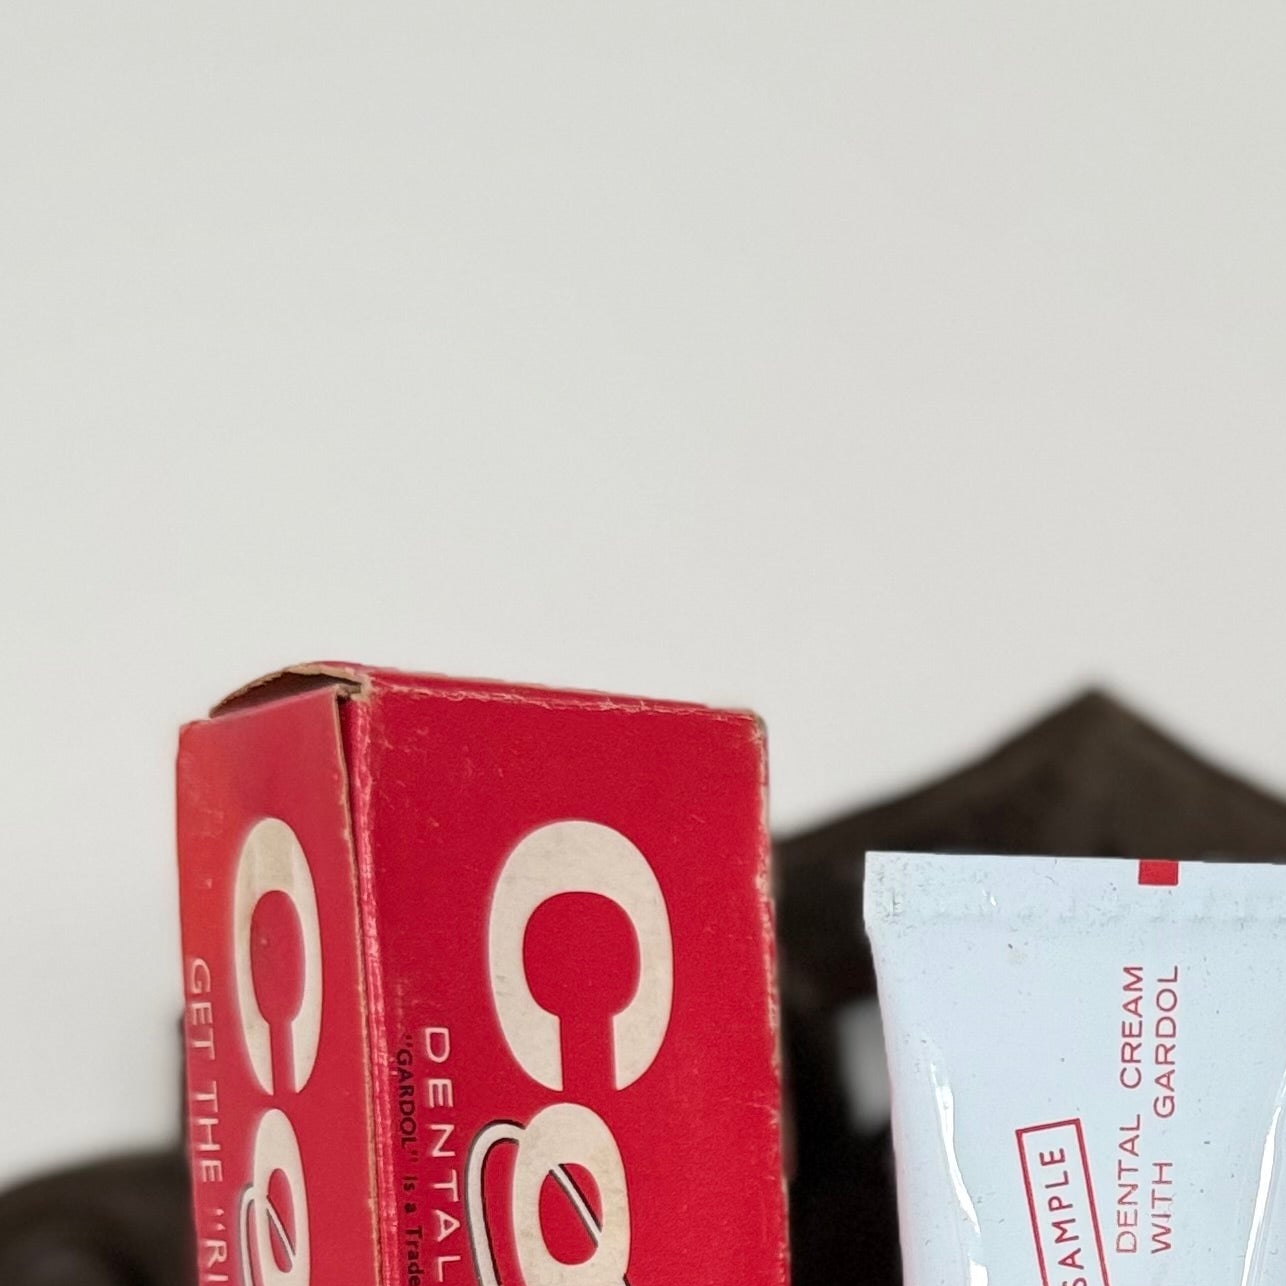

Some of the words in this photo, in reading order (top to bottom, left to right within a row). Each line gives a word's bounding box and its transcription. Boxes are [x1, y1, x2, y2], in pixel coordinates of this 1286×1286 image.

[188, 957, 214, 1060] GET
[1120, 966, 1143, 1089] CREAM
[1153, 966, 1178, 1118] GARDOL
[195, 1082, 222, 1182] THE
[396, 1034, 420, 1163] "GARDOL"
[425, 1027, 461, 1282] DENTAL
[1115, 1114, 1141, 1253] DENTAL
[1151, 1162, 1173, 1253] WITH
